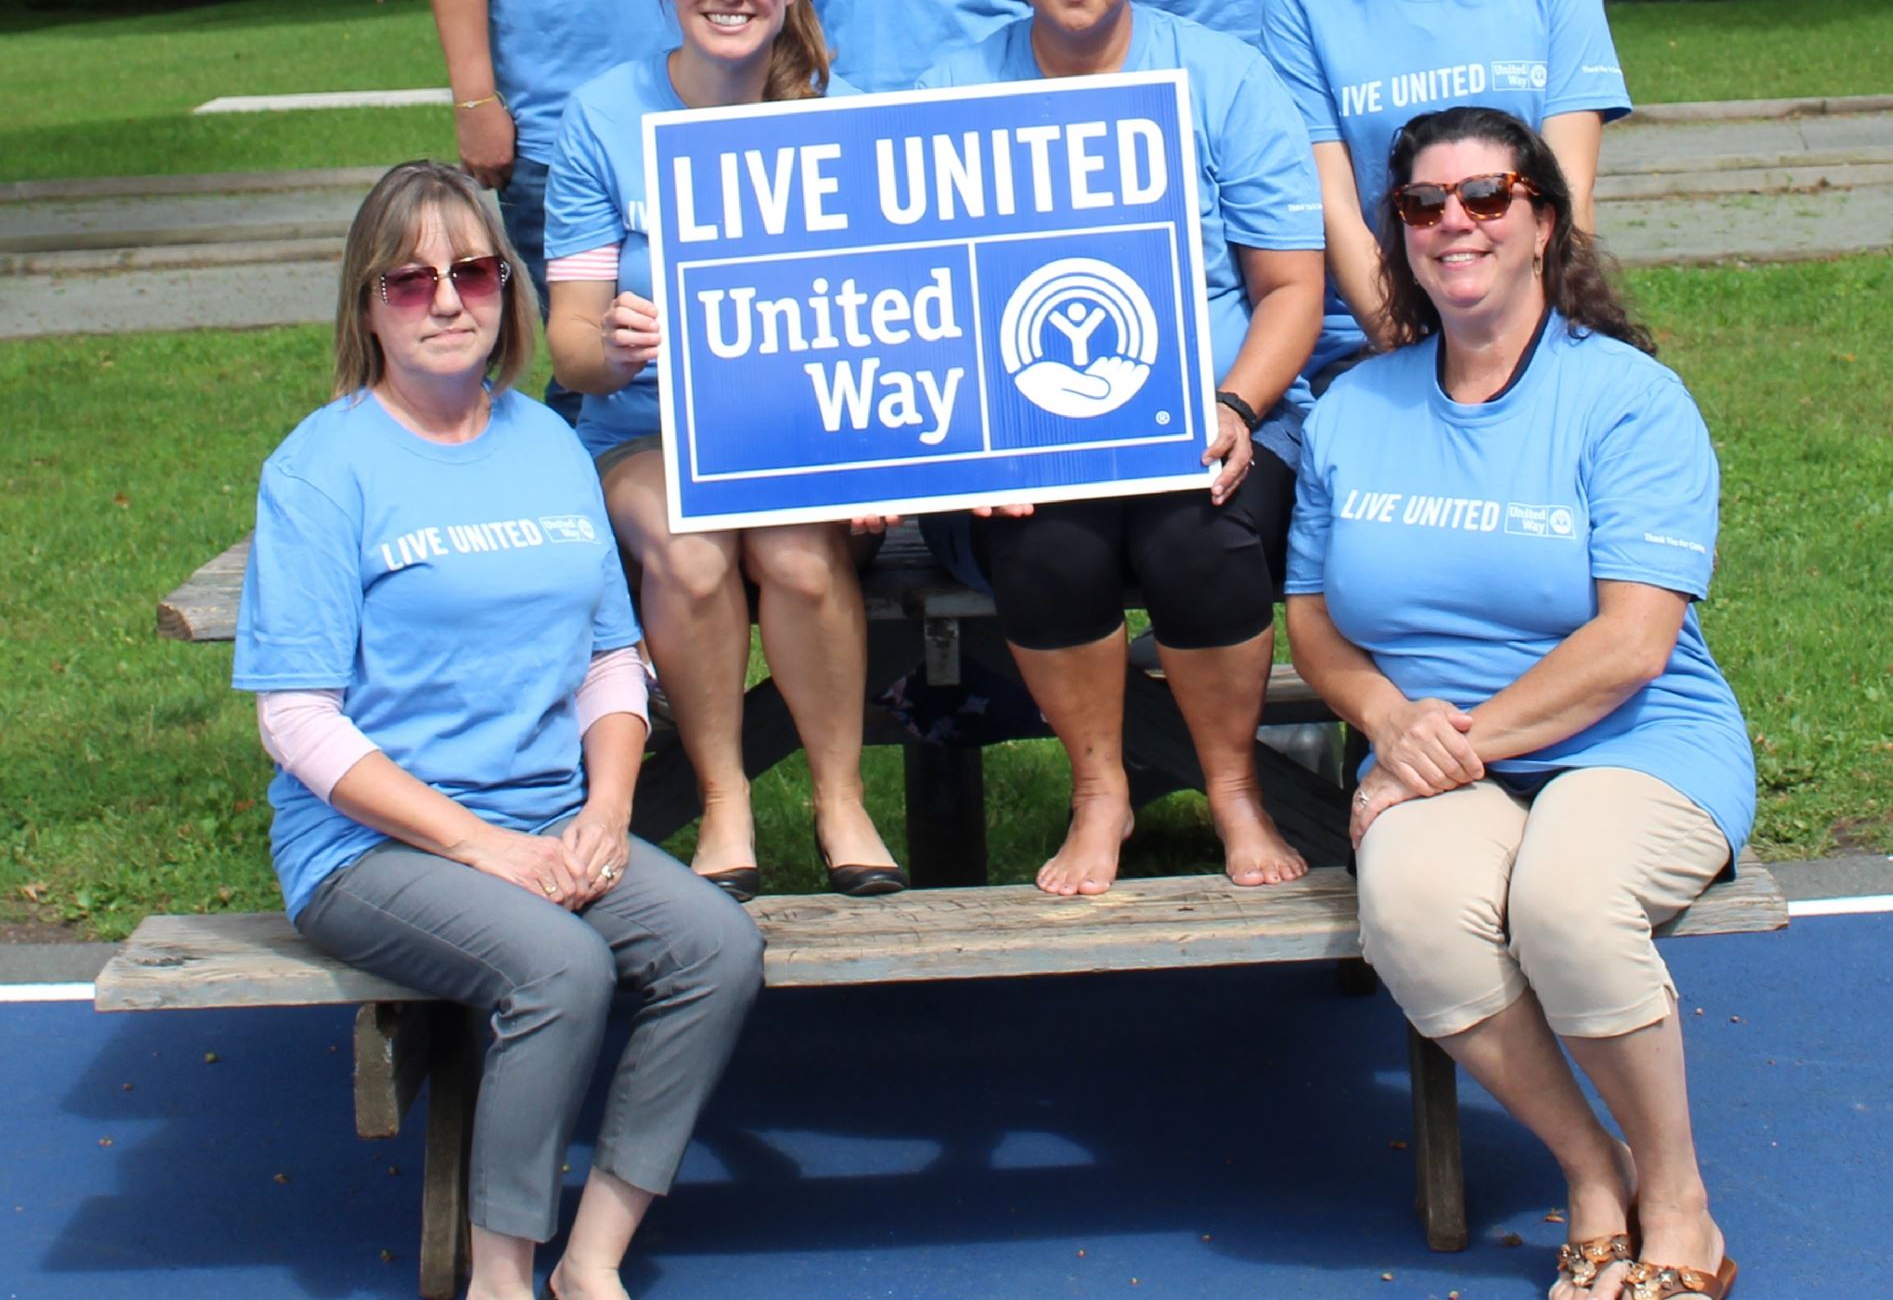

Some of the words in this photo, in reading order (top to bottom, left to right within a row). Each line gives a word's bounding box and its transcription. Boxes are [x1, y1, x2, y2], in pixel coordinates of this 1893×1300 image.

[1334, 80, 1383, 117] IVE
[1391, 64, 1486, 108] UNITED
[673, 143, 848, 243] LIVE
[875, 118, 1169, 225] UNITED
[698, 267, 962, 358] United
[804, 357, 965, 444] Way
[382, 526, 449, 571] LIVE
[447, 519, 543, 554] UNITED
[1340, 490, 1401, 522] LIVE
[1403, 495, 1500, 532] UNITED
